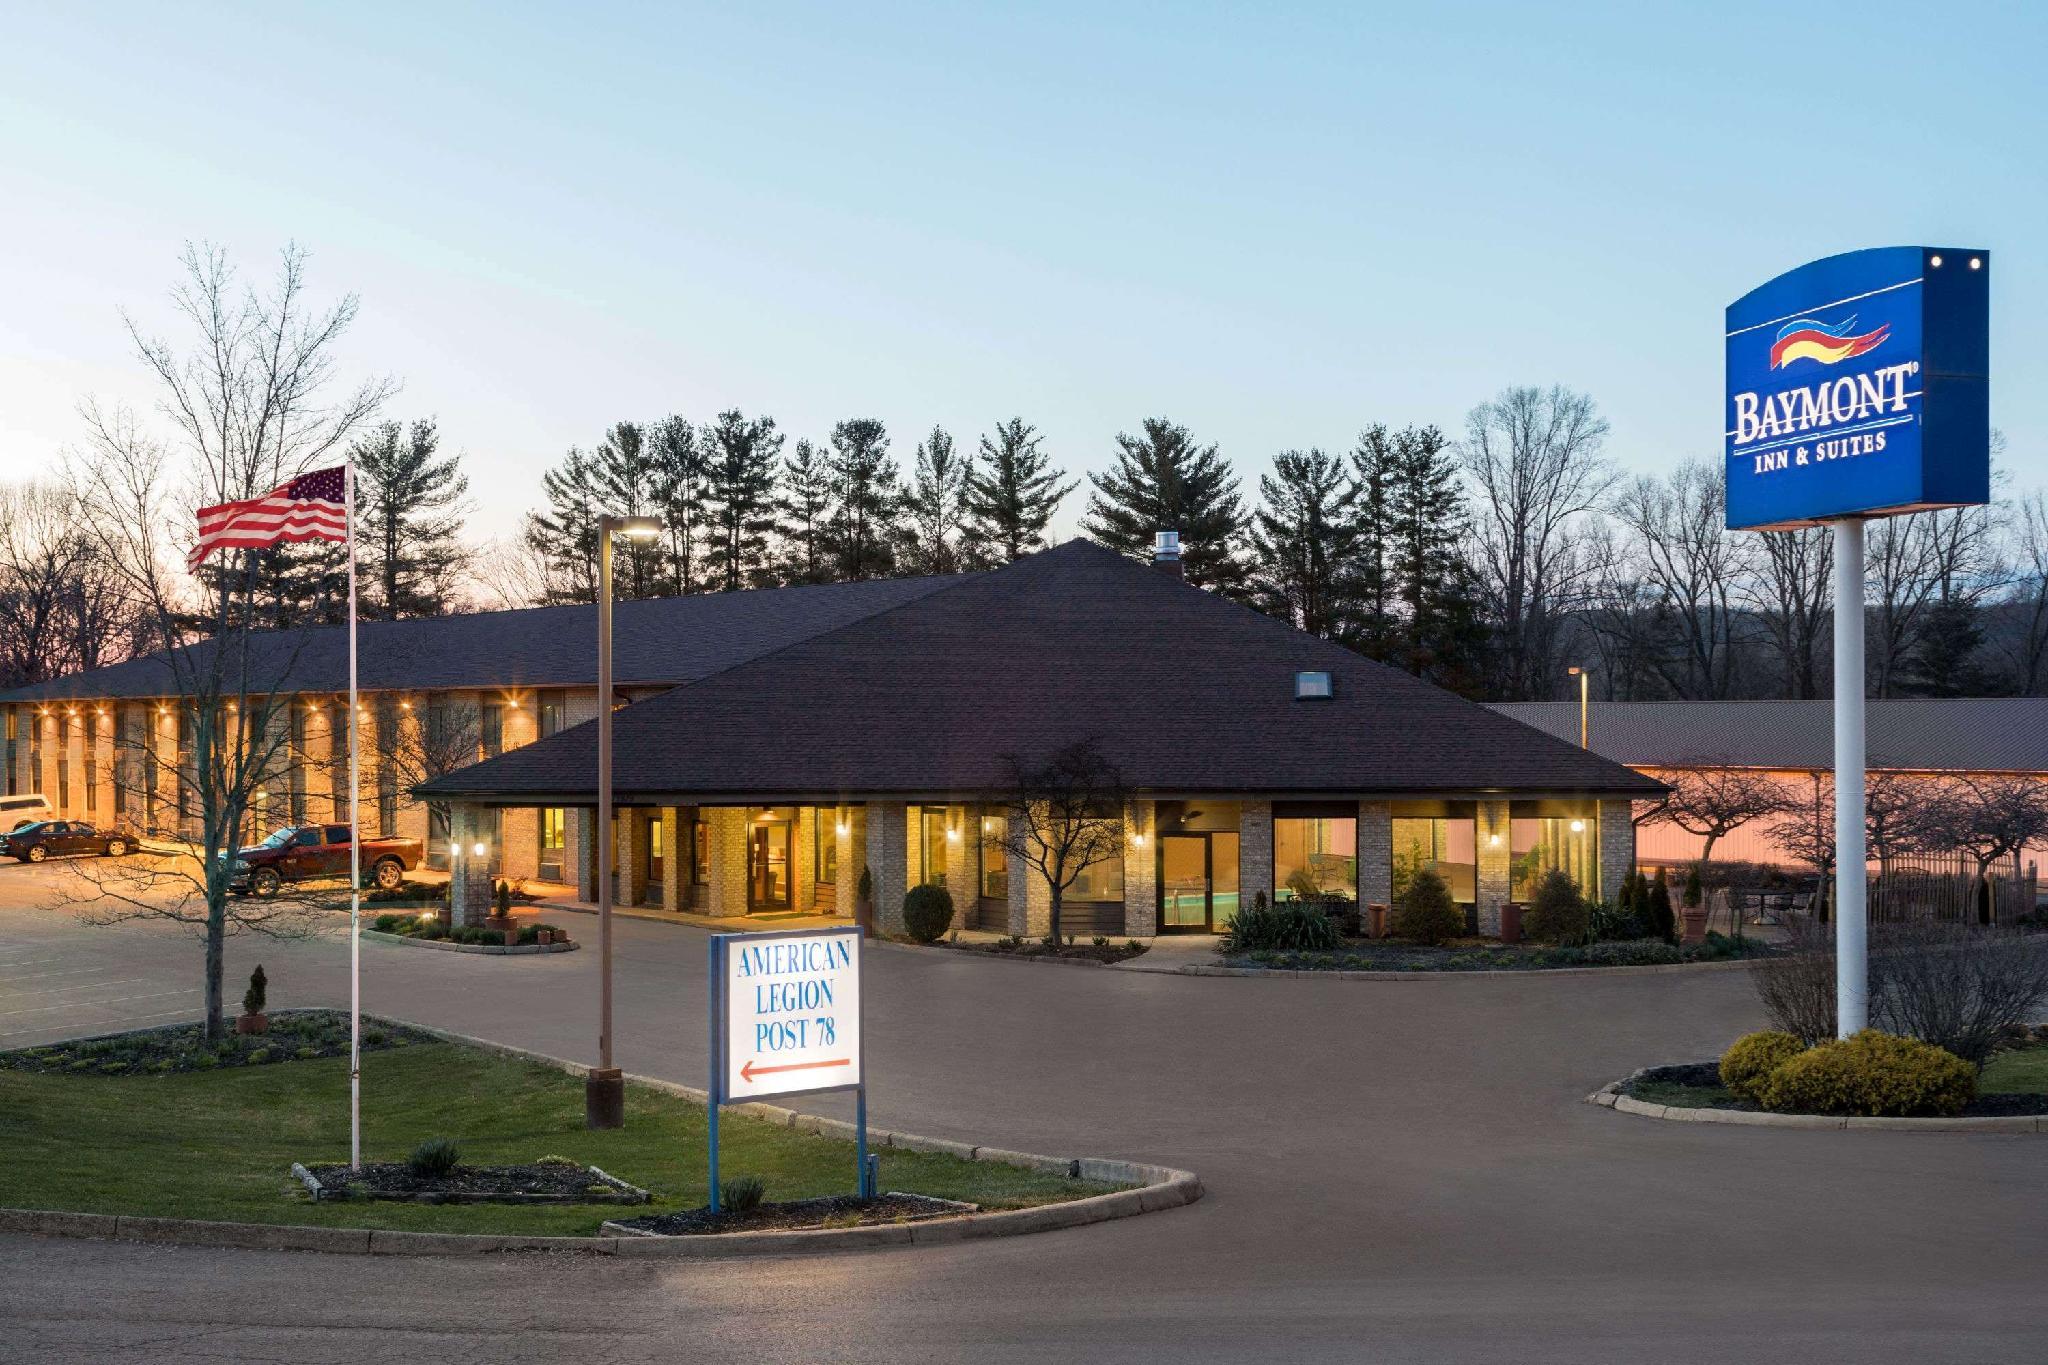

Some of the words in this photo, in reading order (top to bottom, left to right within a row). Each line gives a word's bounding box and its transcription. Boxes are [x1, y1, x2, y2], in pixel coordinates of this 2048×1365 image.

[1734, 363, 1914, 444] BAYMONT
[1755, 450, 1788, 474] INN
[1796, 446, 1809, 466] &
[1816, 432, 1886, 462] SUITES
[738, 940, 851, 977] AMERICAN
[755, 979, 833, 1014] LEGION
[756, 1019, 809, 1053] POST
[816, 1017, 835, 1046] 78
